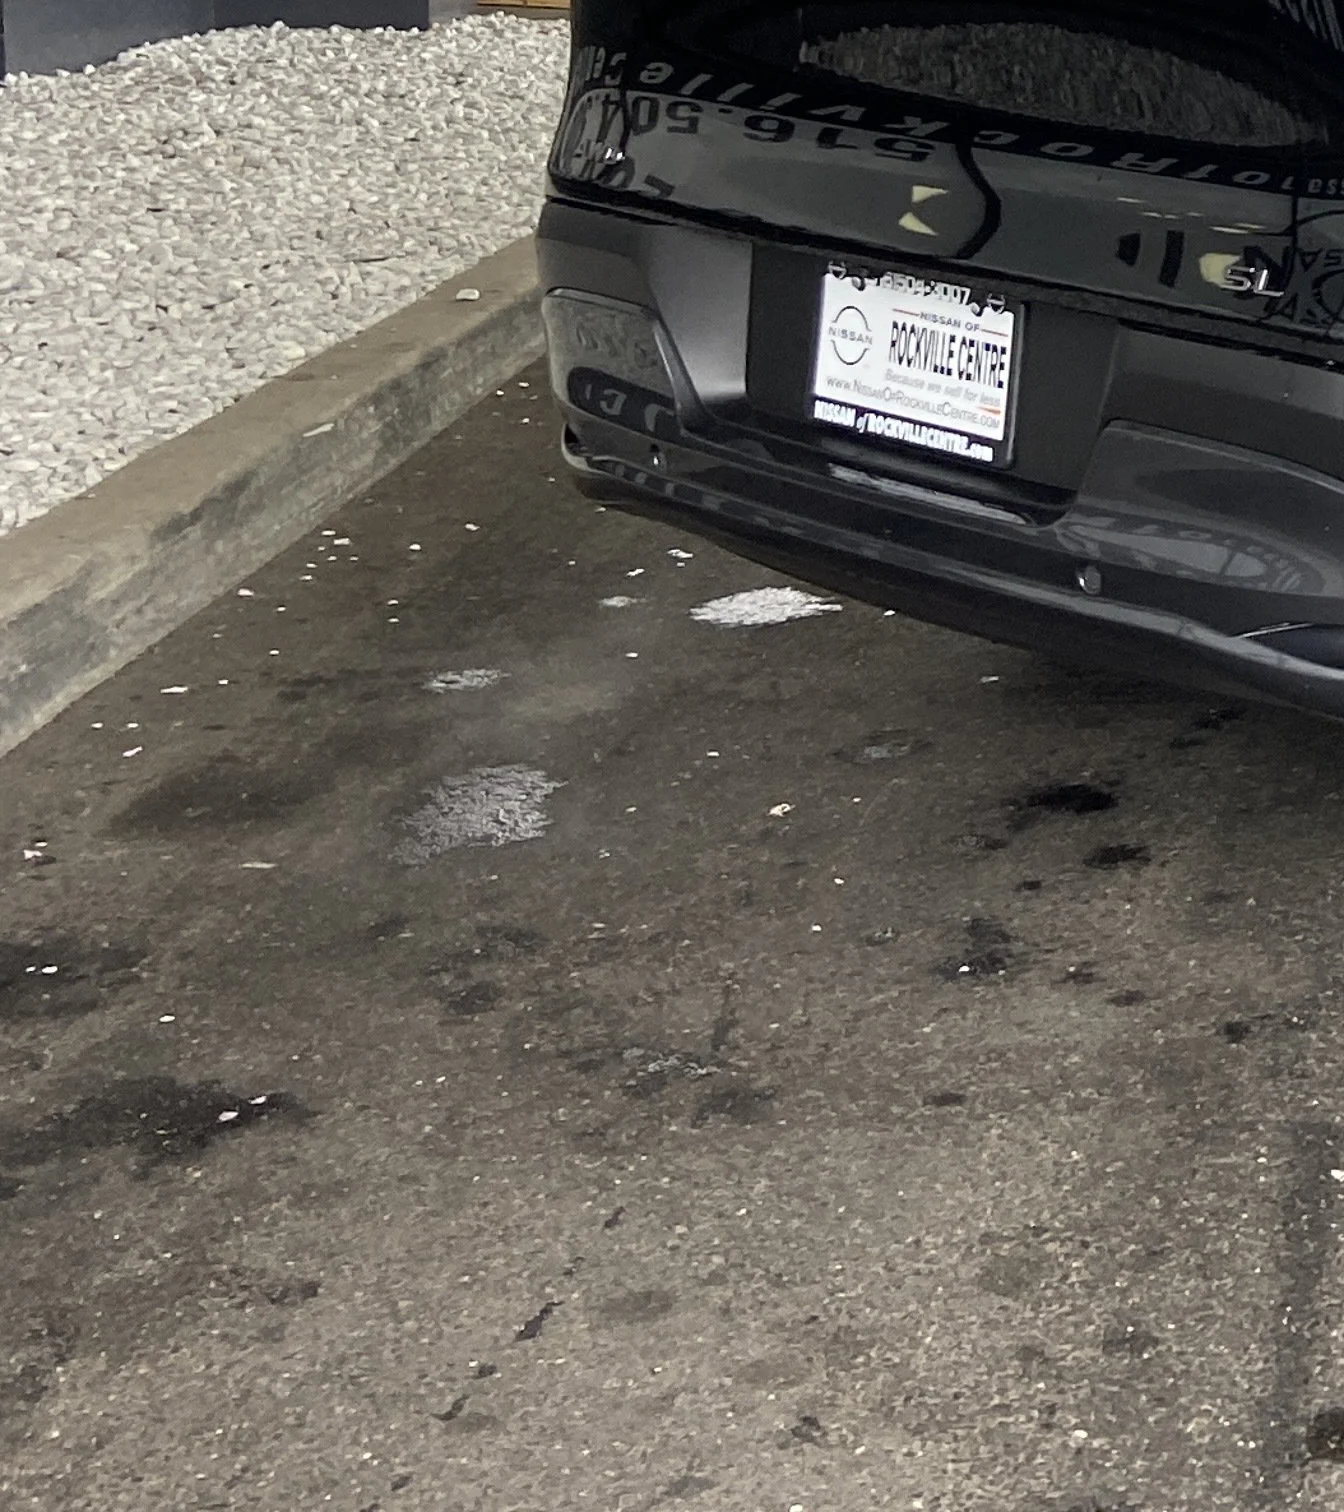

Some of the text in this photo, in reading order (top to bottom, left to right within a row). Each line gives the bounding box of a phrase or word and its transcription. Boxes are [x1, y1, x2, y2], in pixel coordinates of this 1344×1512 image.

[1224, 266, 1285, 297] SL
[828, 326, 873, 346] NISSAN
[919, 311, 980, 333] NISSAN OF
[888, 320, 1007, 390] ROCKVILLE CENTRE
[885, 368, 1001, 405] Because we sell for less
[813, 399, 857, 428] NISSAN
